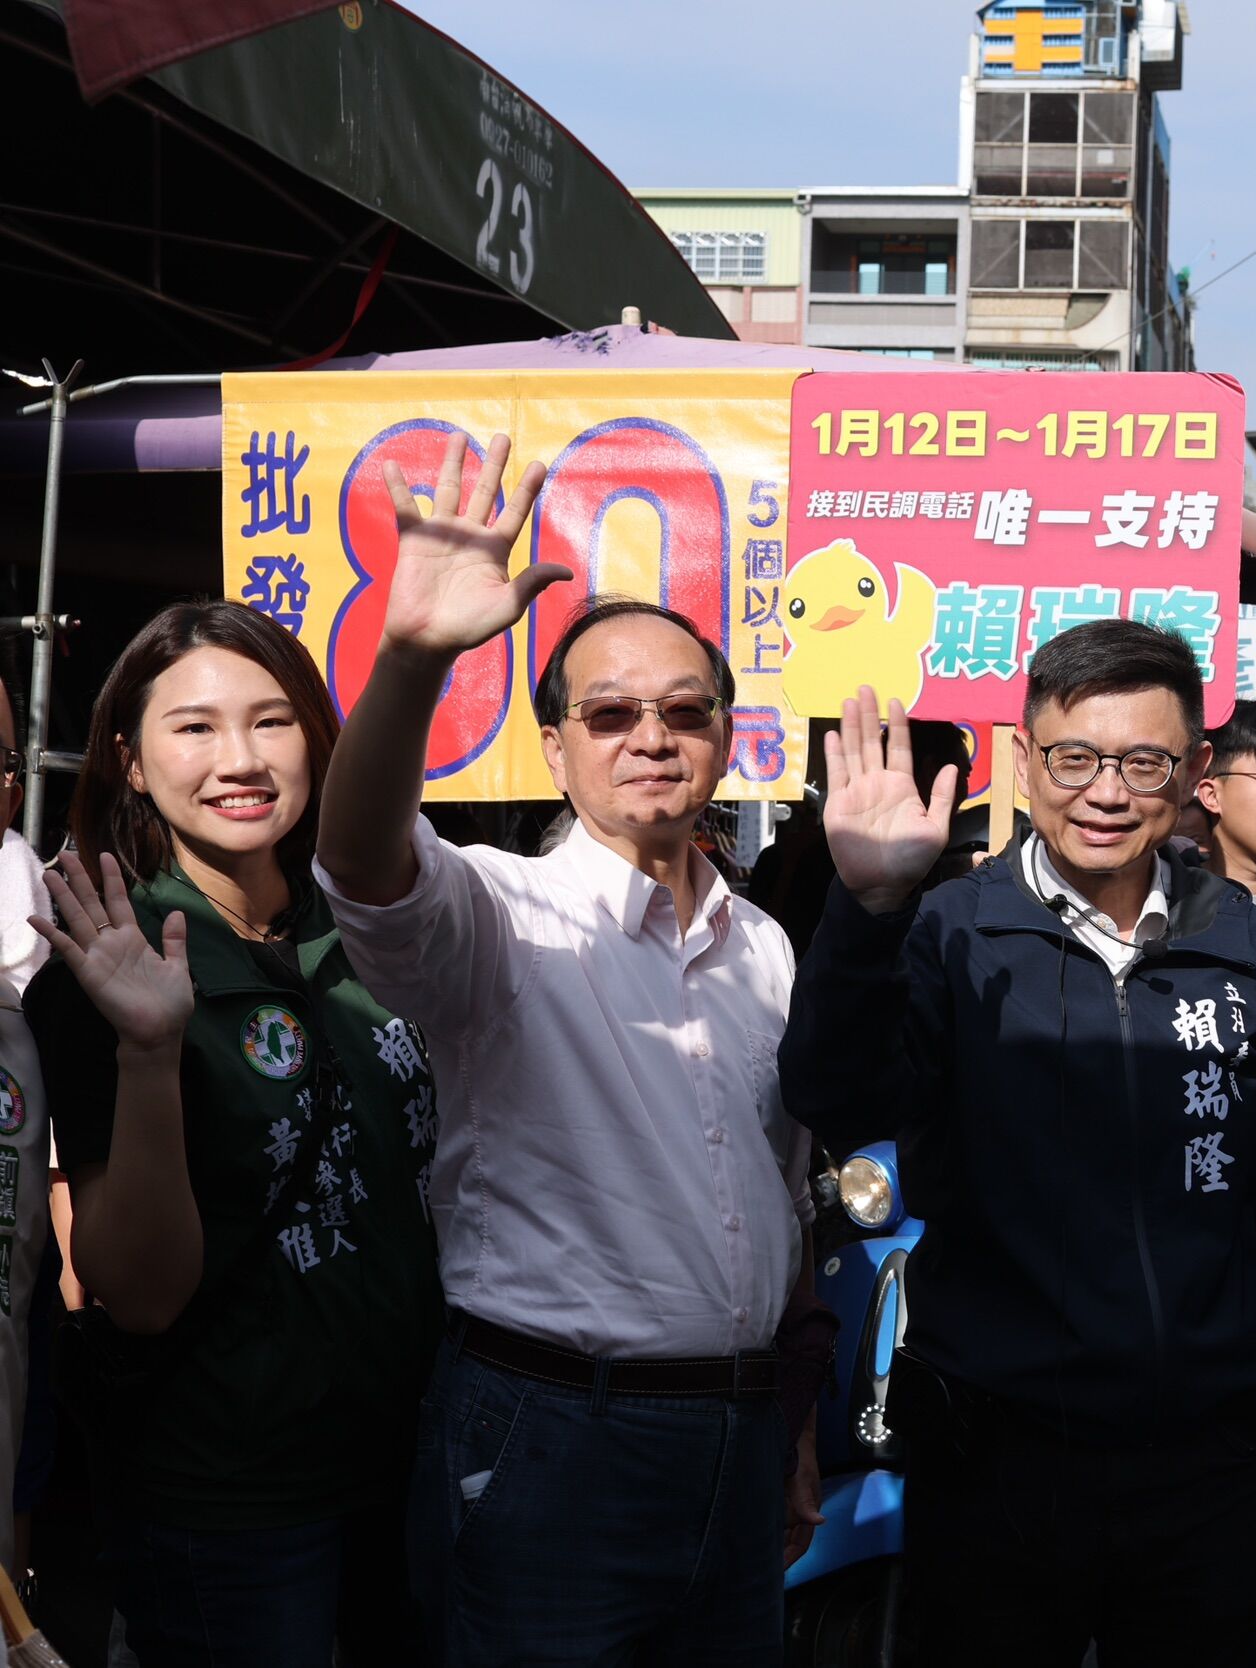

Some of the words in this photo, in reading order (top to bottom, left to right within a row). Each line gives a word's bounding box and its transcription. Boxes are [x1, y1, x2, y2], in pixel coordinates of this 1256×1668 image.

[475, 157, 535, 295] 23
[326, 416, 731, 782] 80
[740, 480, 783, 675] 5個以上
[805, 489, 974, 521] 接到民調電話
[973, 487, 1220, 550] 唯一支持
[1171, 998, 1236, 1193] 賴瑞隆
